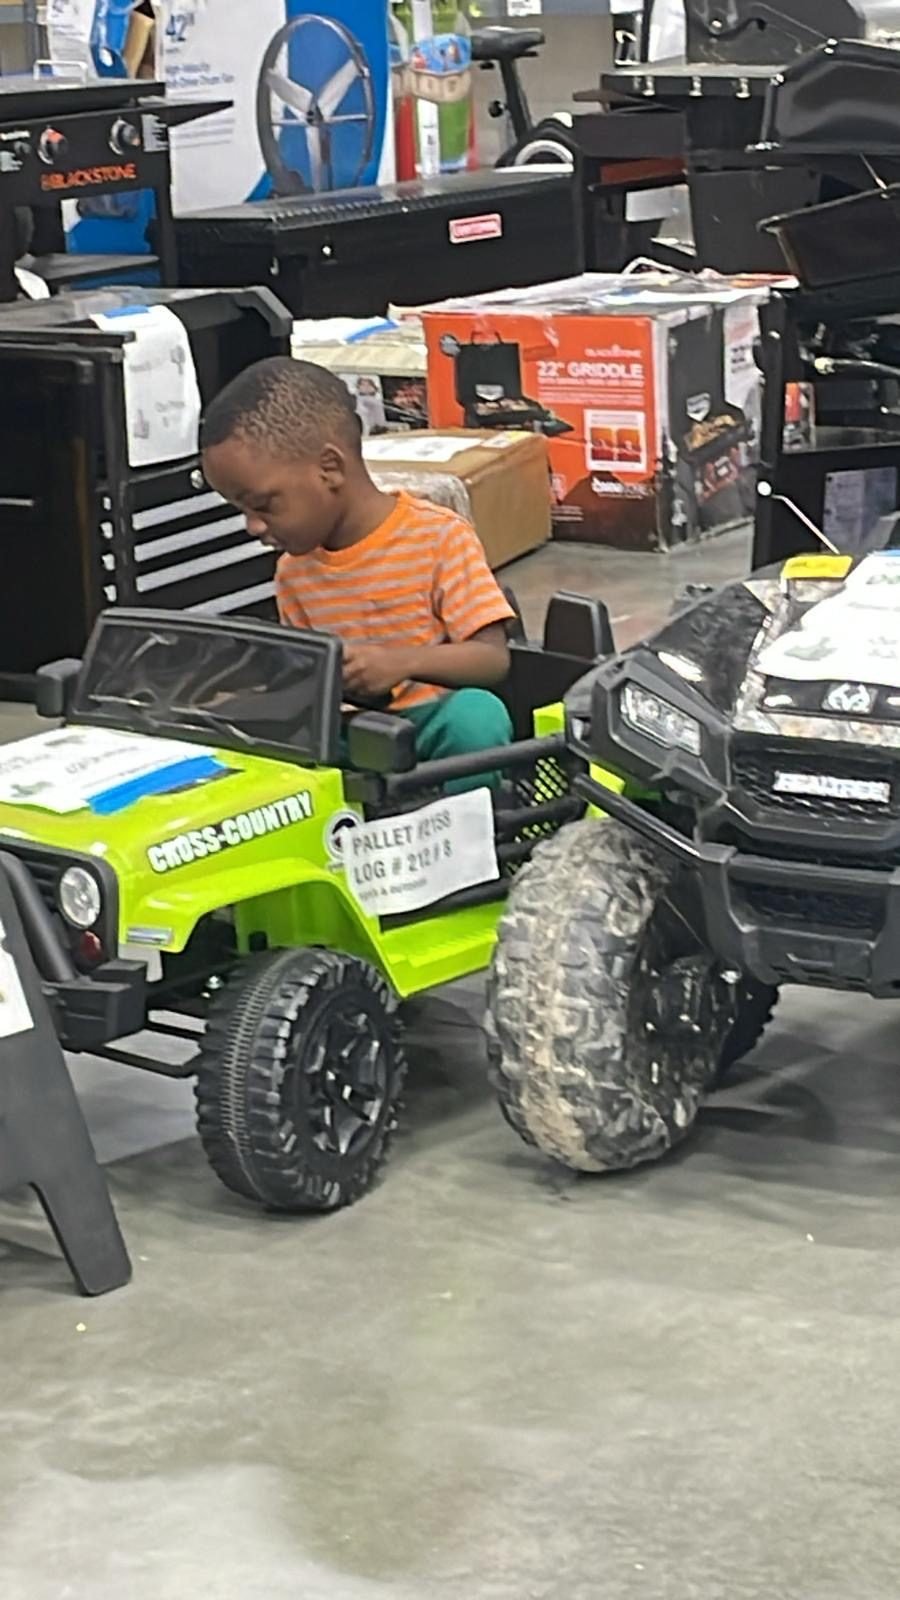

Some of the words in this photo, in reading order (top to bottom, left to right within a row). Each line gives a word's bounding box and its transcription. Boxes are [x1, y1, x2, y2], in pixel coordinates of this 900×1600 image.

[536, 361, 565, 377] 22"
[567, 361, 645, 379] GRIDDLE
[146, 790, 314, 874] CROSS-COUNTRY
[352, 825, 414, 856] PALLET
[353, 860, 386, 885] LOG
[392, 857, 402, 876] #
